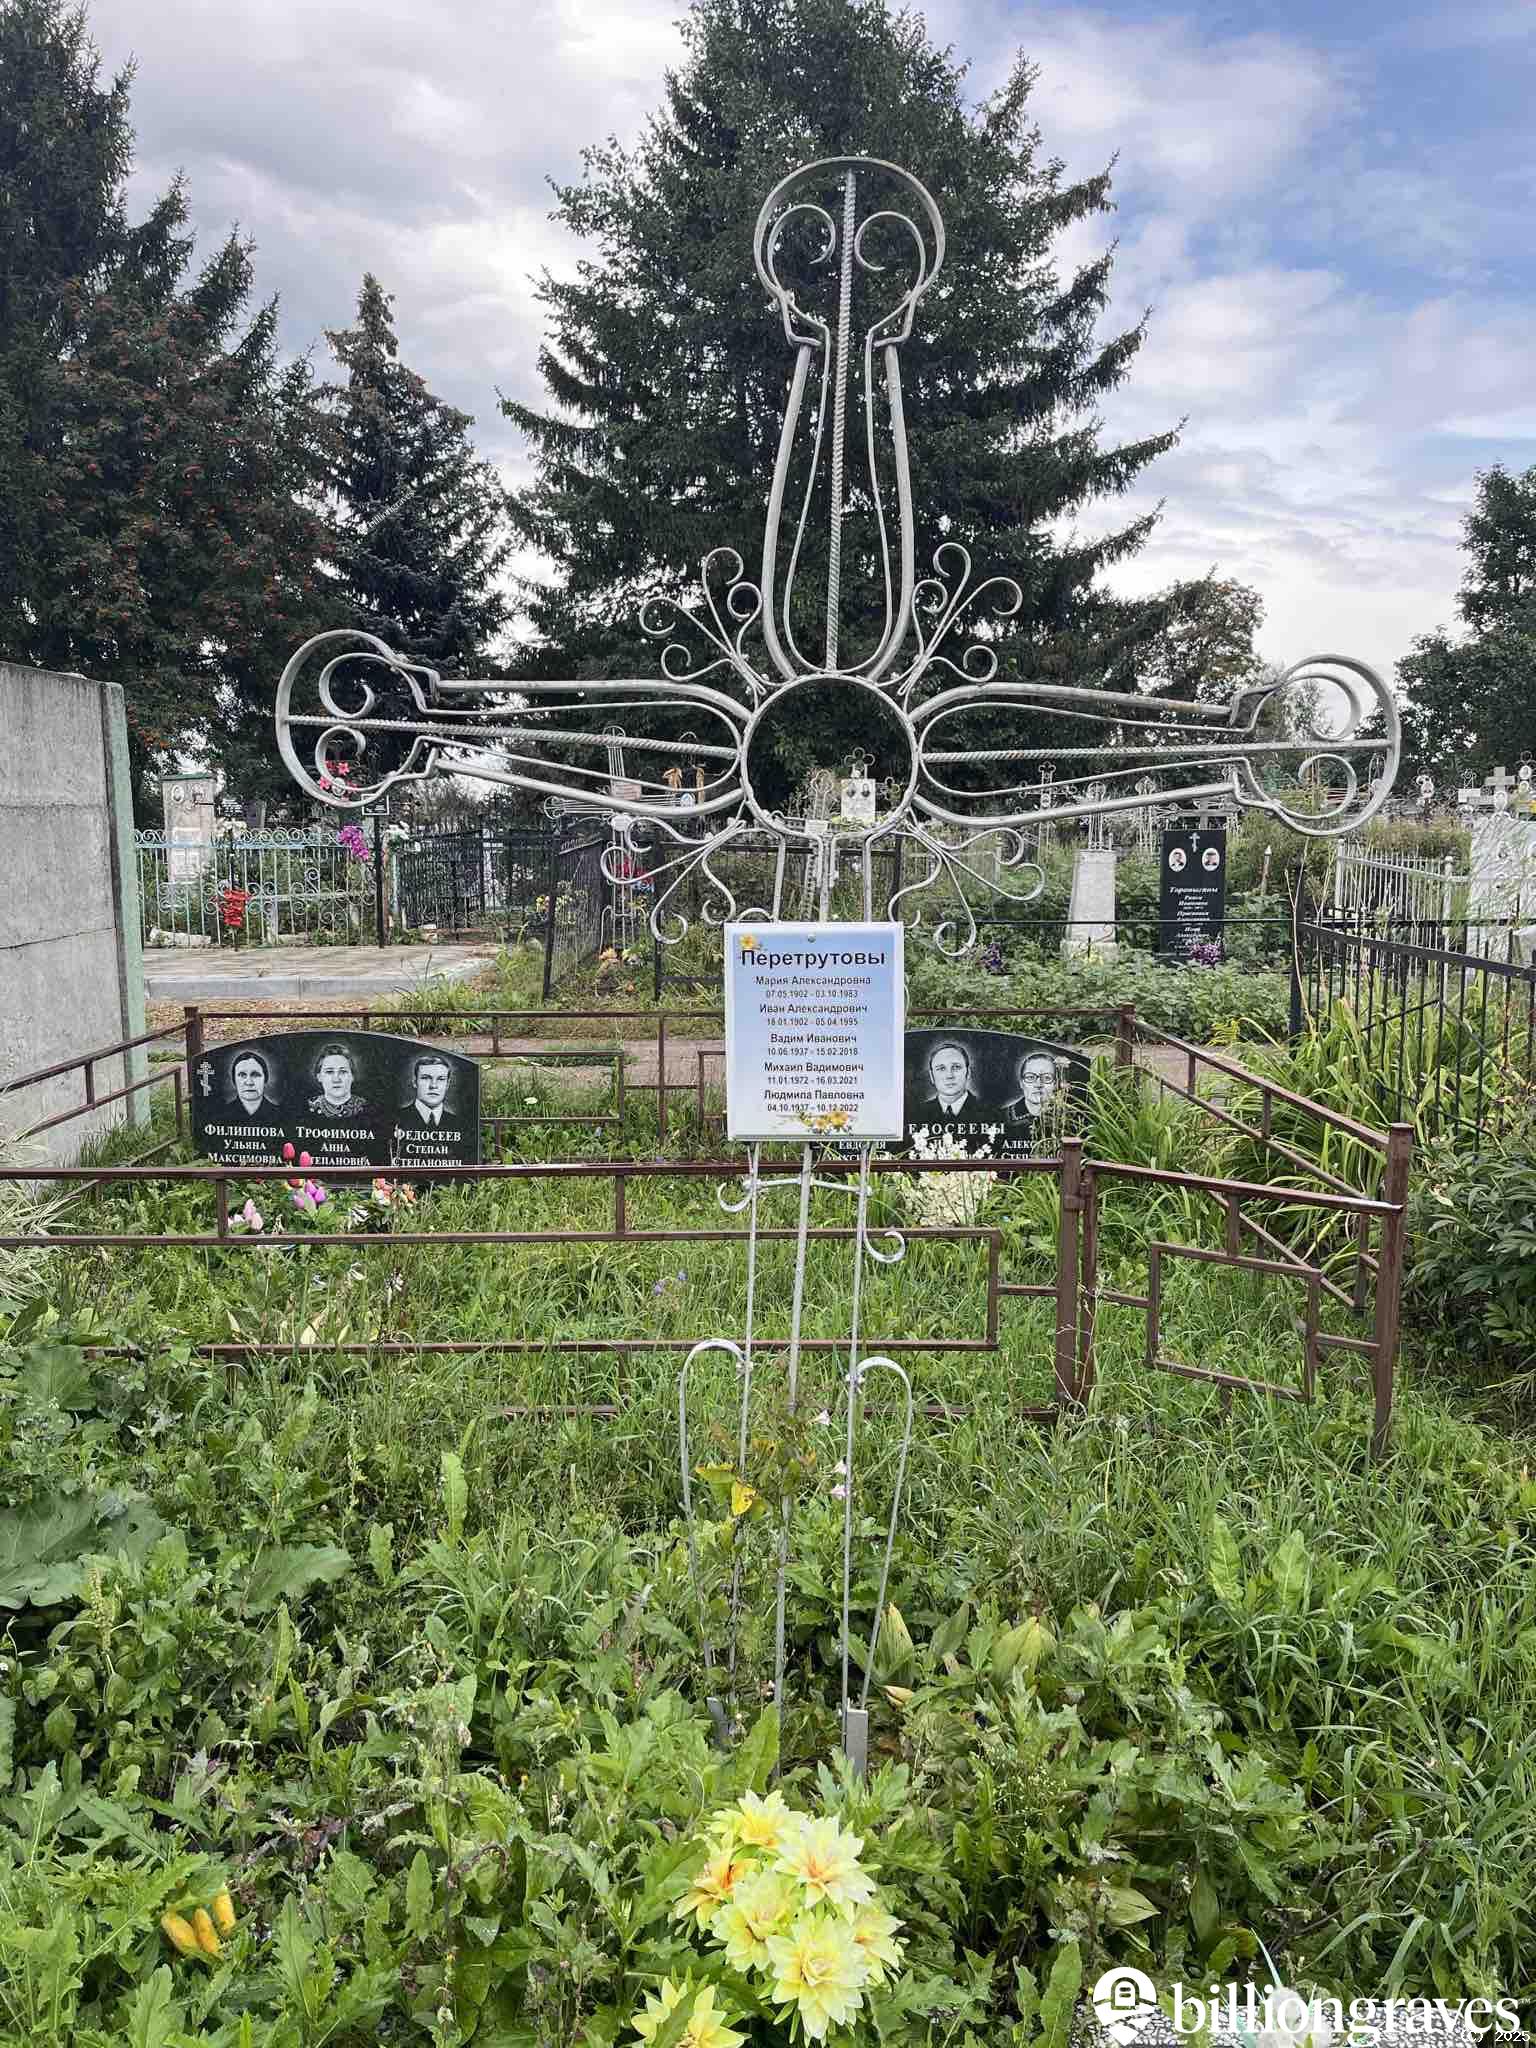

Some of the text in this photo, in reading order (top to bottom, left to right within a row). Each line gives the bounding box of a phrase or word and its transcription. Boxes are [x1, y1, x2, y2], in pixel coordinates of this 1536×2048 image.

[741, 950, 885, 968] Перетрутовы
[755, 976, 871, 986] Мария Александровна
[760, 1004, 867, 1014] Иван Александрович
[771, 1034, 857, 1044] Вадим Иванович
[764, 1063, 864, 1072] Михаил Вадимович
[764, 1090, 864, 1100] Людмила Павловна
[768, 1104, 808, 1112] 04.10.1937
